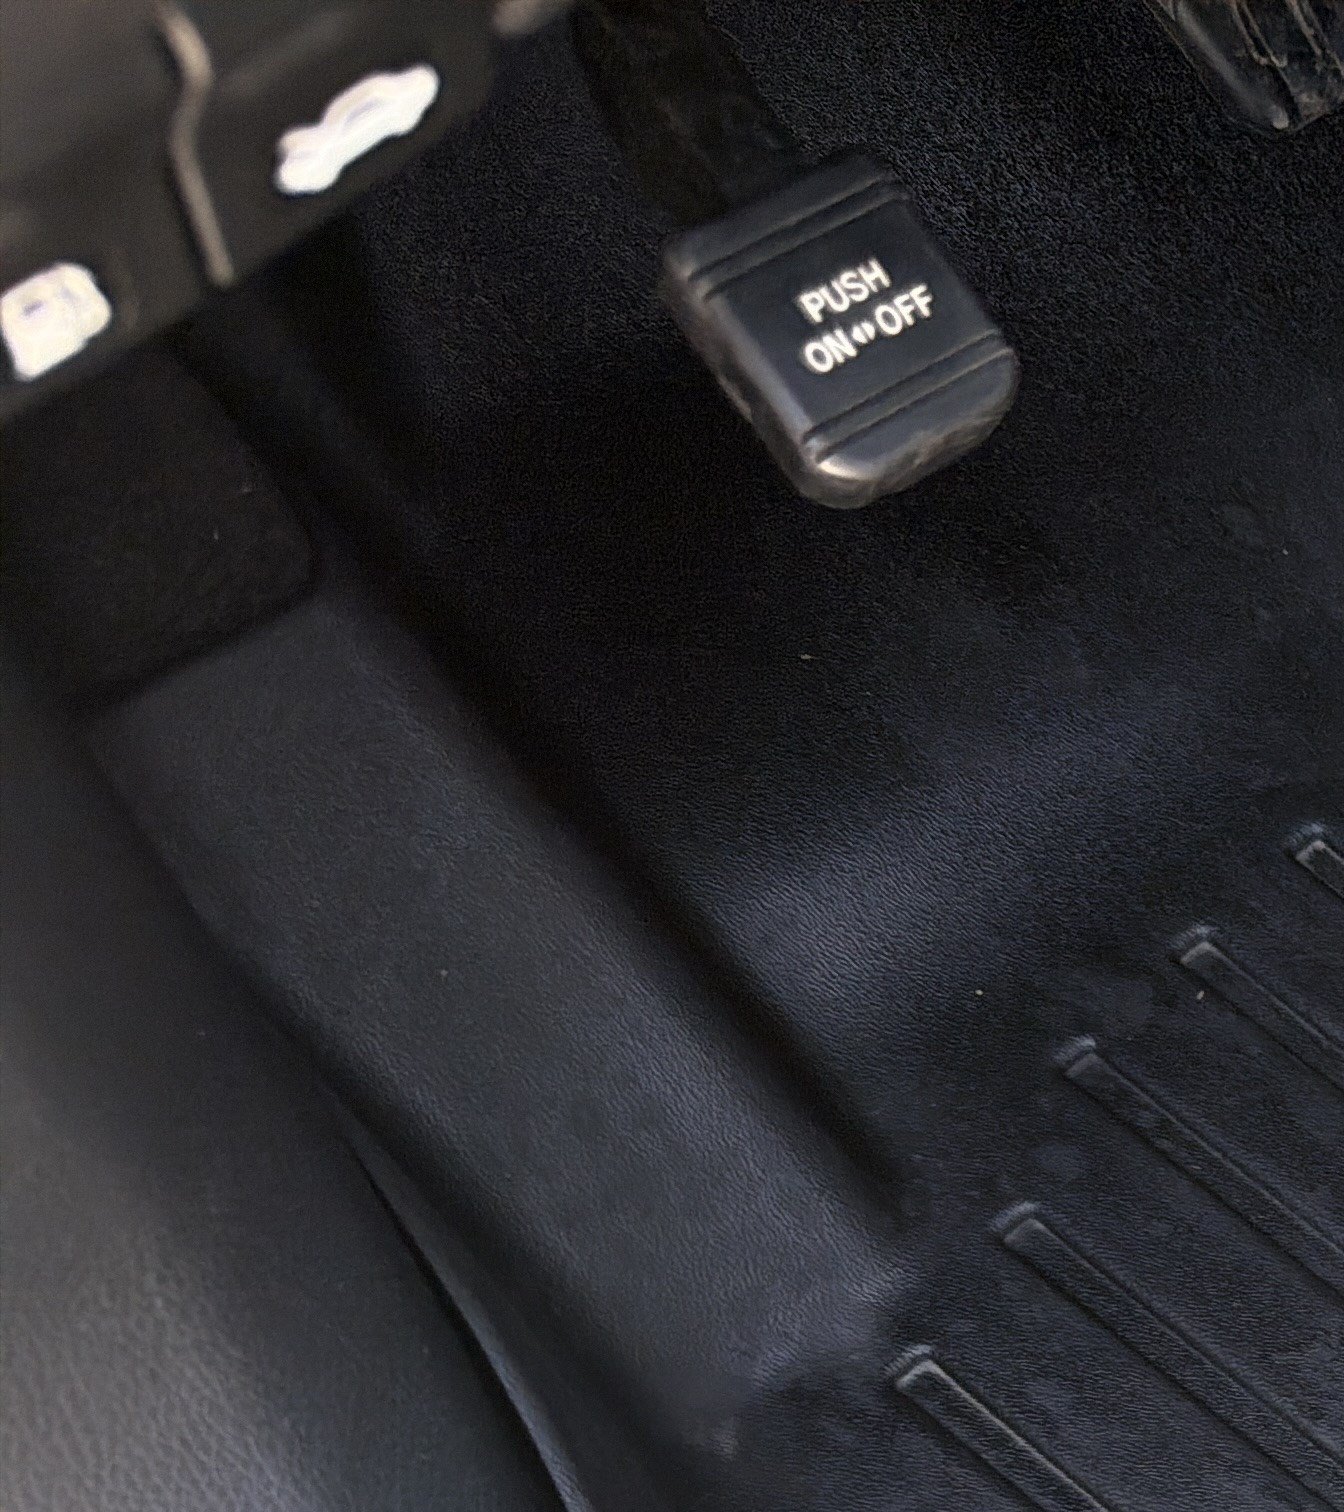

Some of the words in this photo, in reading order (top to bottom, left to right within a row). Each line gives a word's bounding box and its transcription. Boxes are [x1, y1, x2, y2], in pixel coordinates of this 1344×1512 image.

[799, 258, 892, 323] PUSH
[804, 327, 858, 373] ON
[874, 283, 933, 336] OFF
